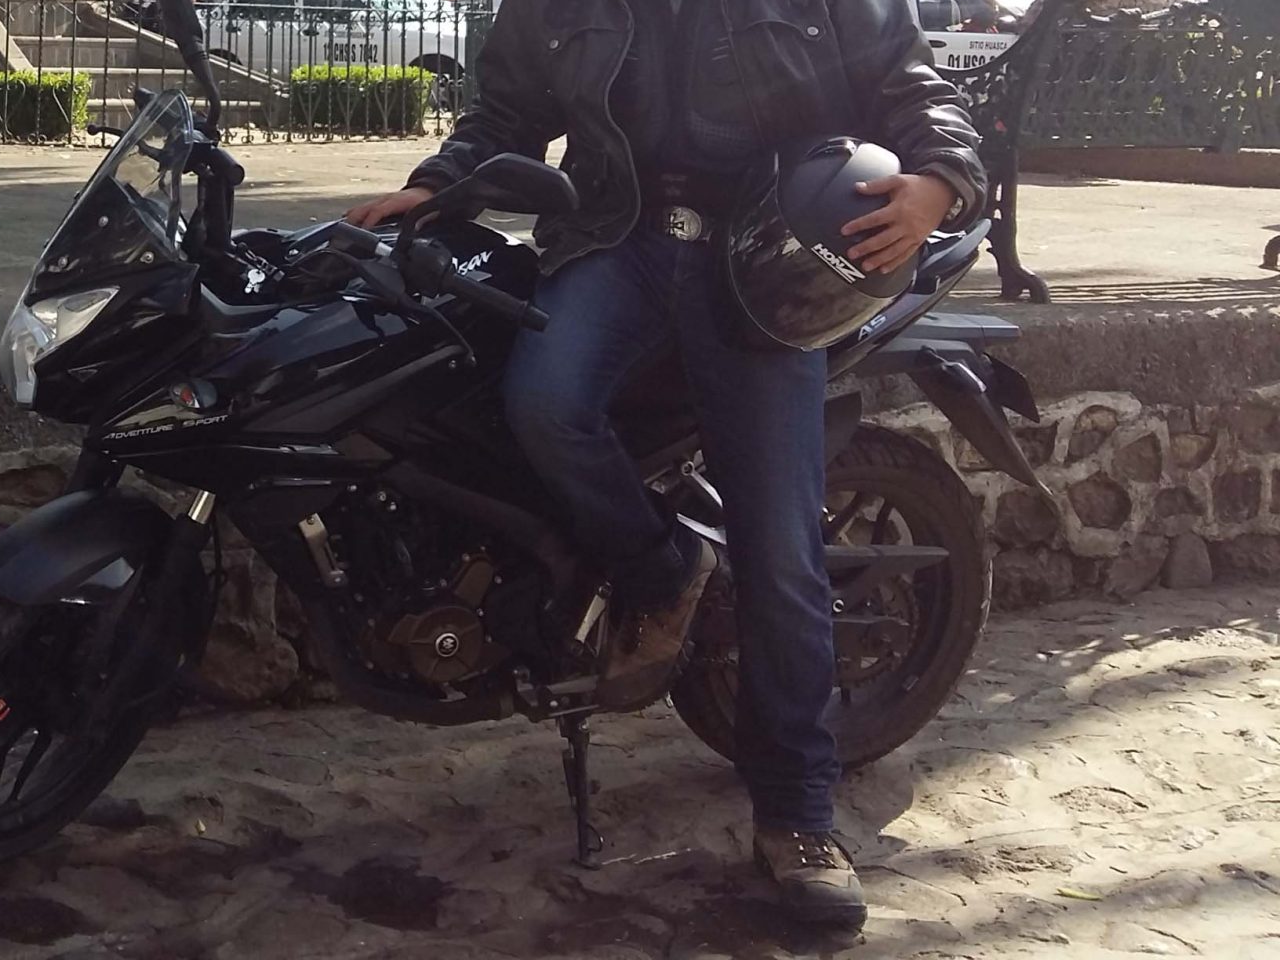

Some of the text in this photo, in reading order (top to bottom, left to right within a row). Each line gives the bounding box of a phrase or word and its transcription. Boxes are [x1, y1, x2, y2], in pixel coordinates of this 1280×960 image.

[969, 41, 1008, 50] SITIO HUASCA
[858, 314, 887, 341] AS
[102, 414, 229, 440] ADVENTURE SPORT
